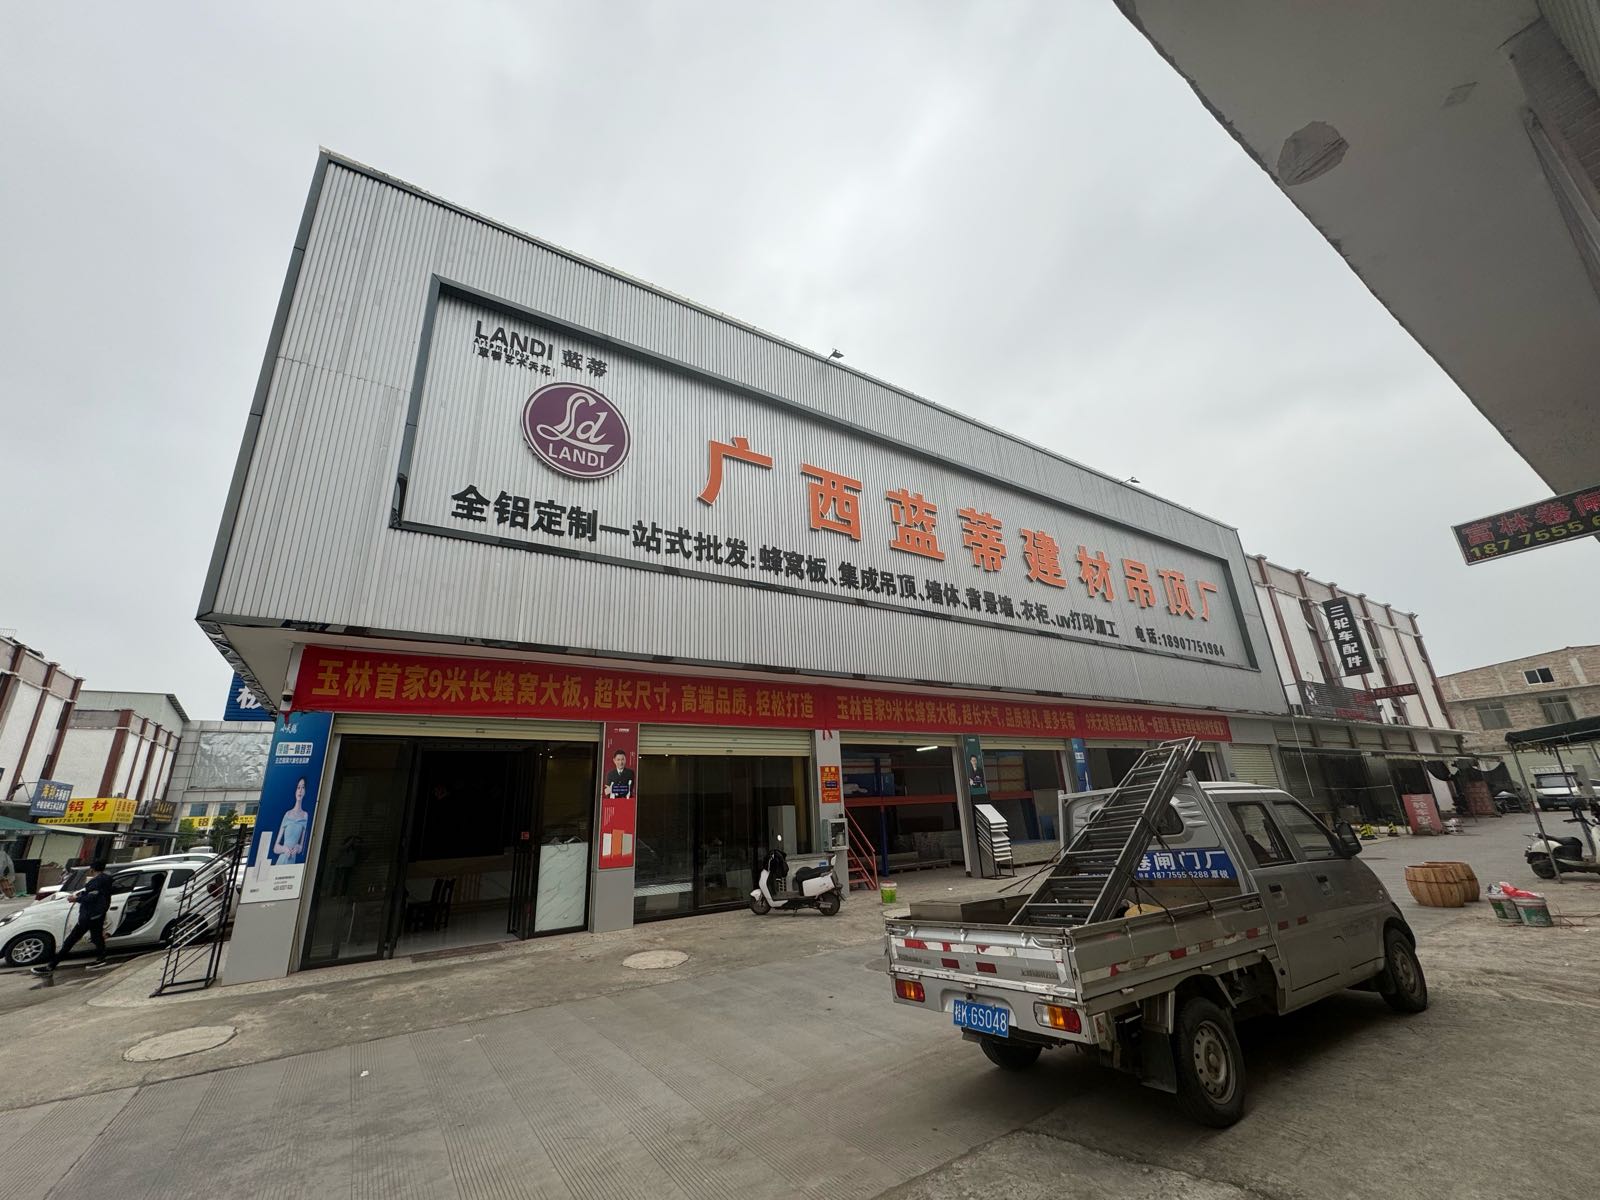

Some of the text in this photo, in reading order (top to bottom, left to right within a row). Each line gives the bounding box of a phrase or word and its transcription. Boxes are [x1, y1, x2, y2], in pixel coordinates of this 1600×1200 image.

[475, 320, 553, 361] LANDI
[548, 443, 605, 470] LANDI
[697, 436, 1218, 622] 广西蓝蒂建材吊顶厂
[1470, 539, 1511, 558] 187
[1518, 520, 1585, 545] 7555
[1330, 604, 1363, 669] 三轮车配件
[68, 800, 109, 813] 铝材
[1168, 871, 1187, 879] 7555
